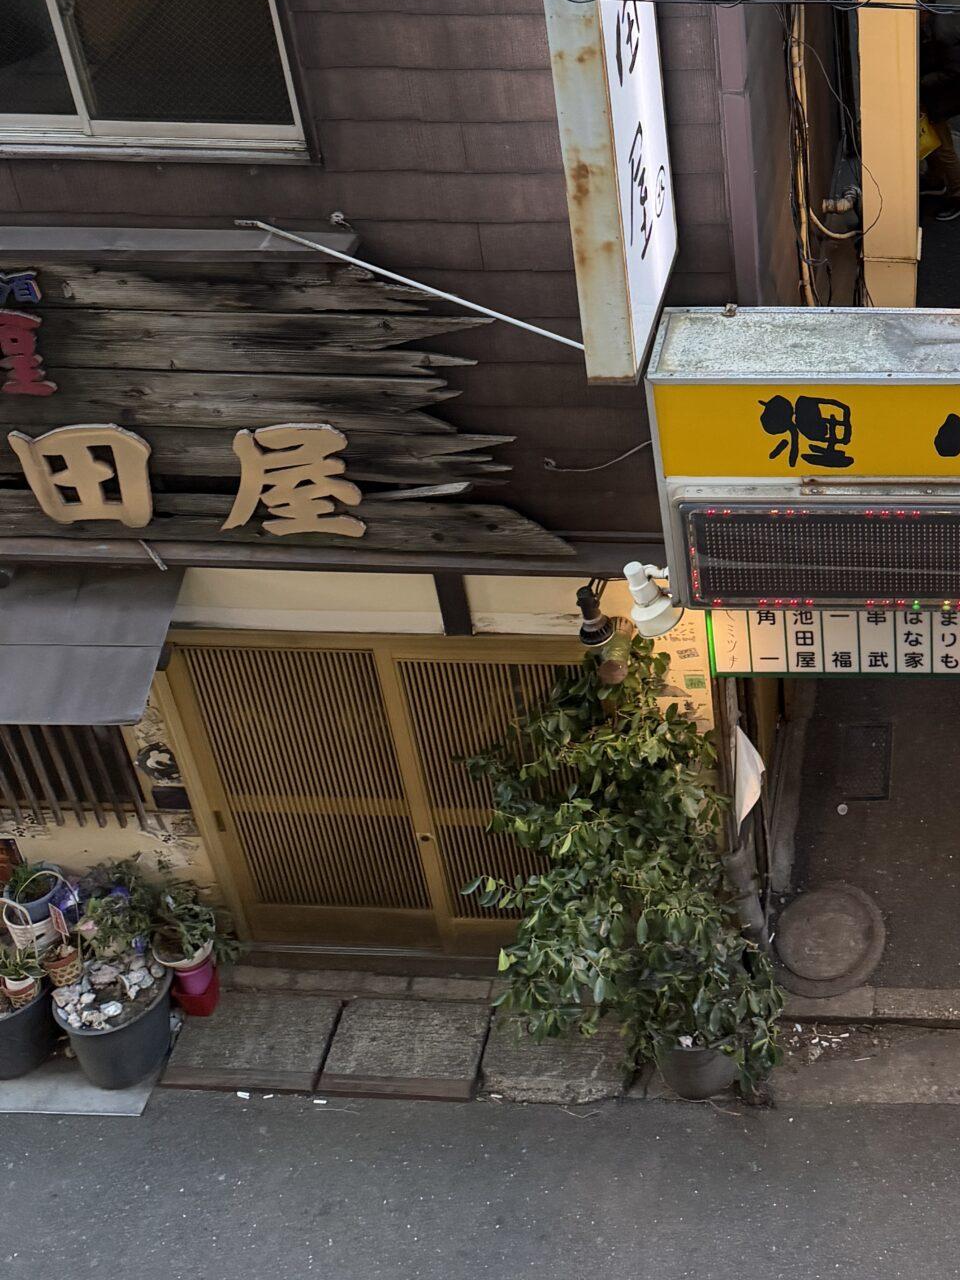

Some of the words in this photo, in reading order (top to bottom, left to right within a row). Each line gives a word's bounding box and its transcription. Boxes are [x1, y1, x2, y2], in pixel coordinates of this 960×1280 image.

[8, 422, 367, 538] 田屋
[793, 609, 818, 668] 池田屋
[866, 609, 889, 668] 串武
[903, 610, 925, 668] はな家
[940, 610, 960, 669] まりも
